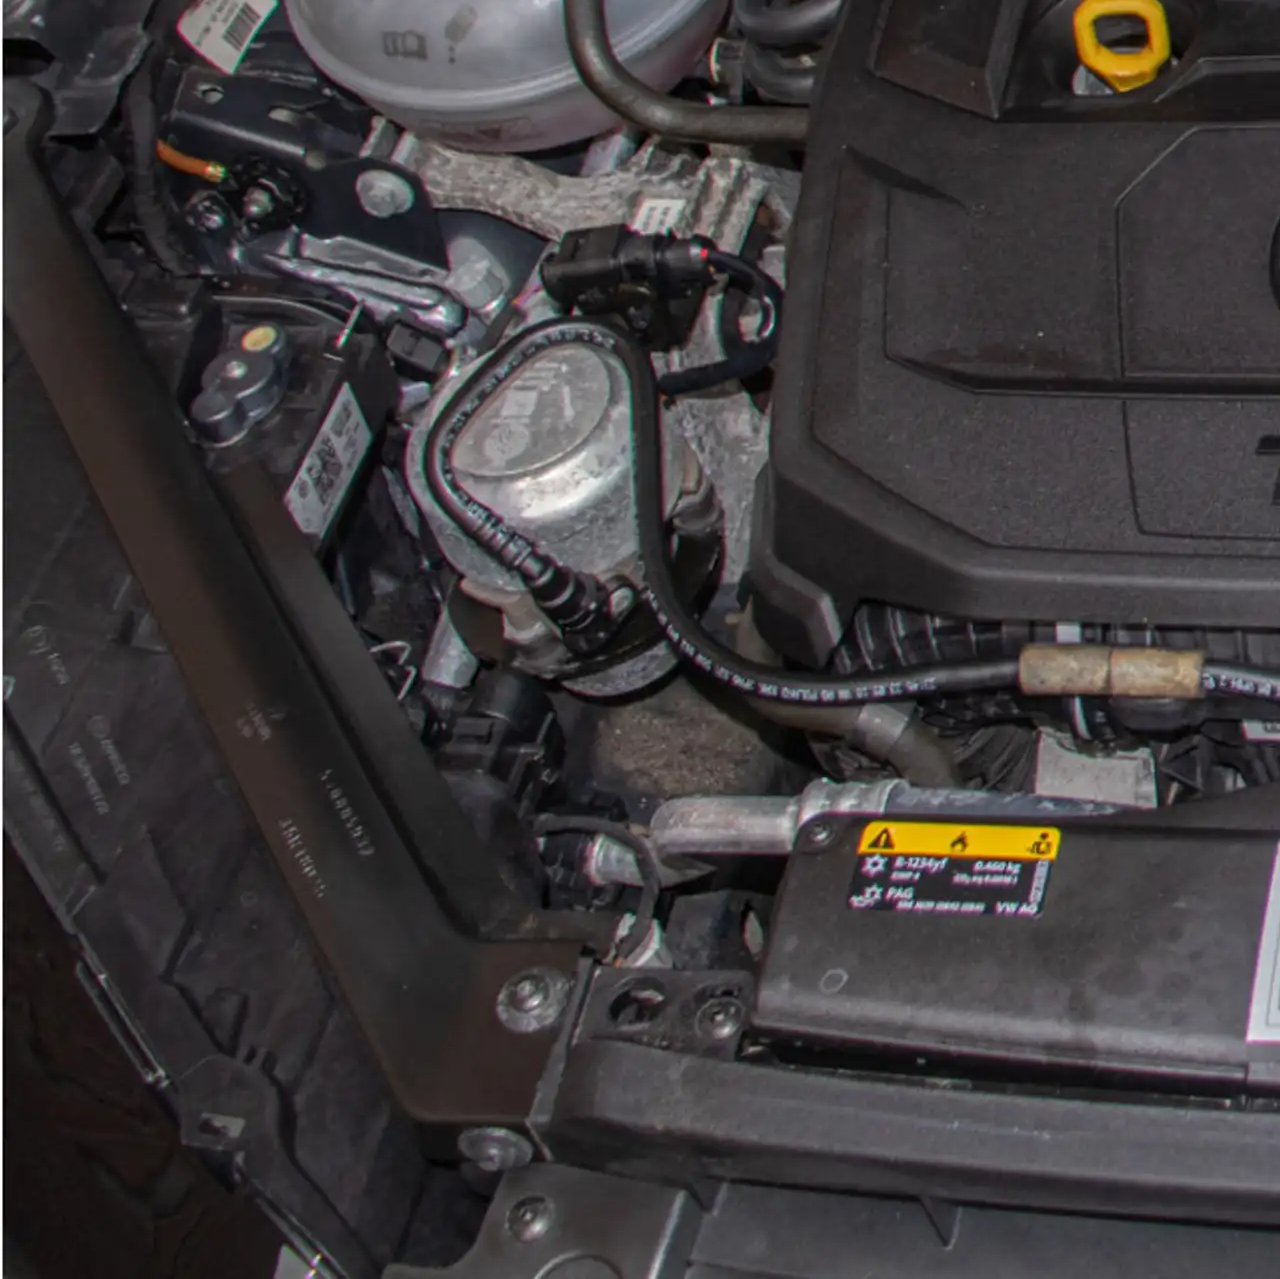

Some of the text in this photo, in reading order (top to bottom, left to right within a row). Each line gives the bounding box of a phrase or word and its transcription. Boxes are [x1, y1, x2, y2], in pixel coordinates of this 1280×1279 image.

[886, 887, 914, 899] PAG
[996, 901, 1017, 911] VW
[1017, 903, 1039, 914] AG
